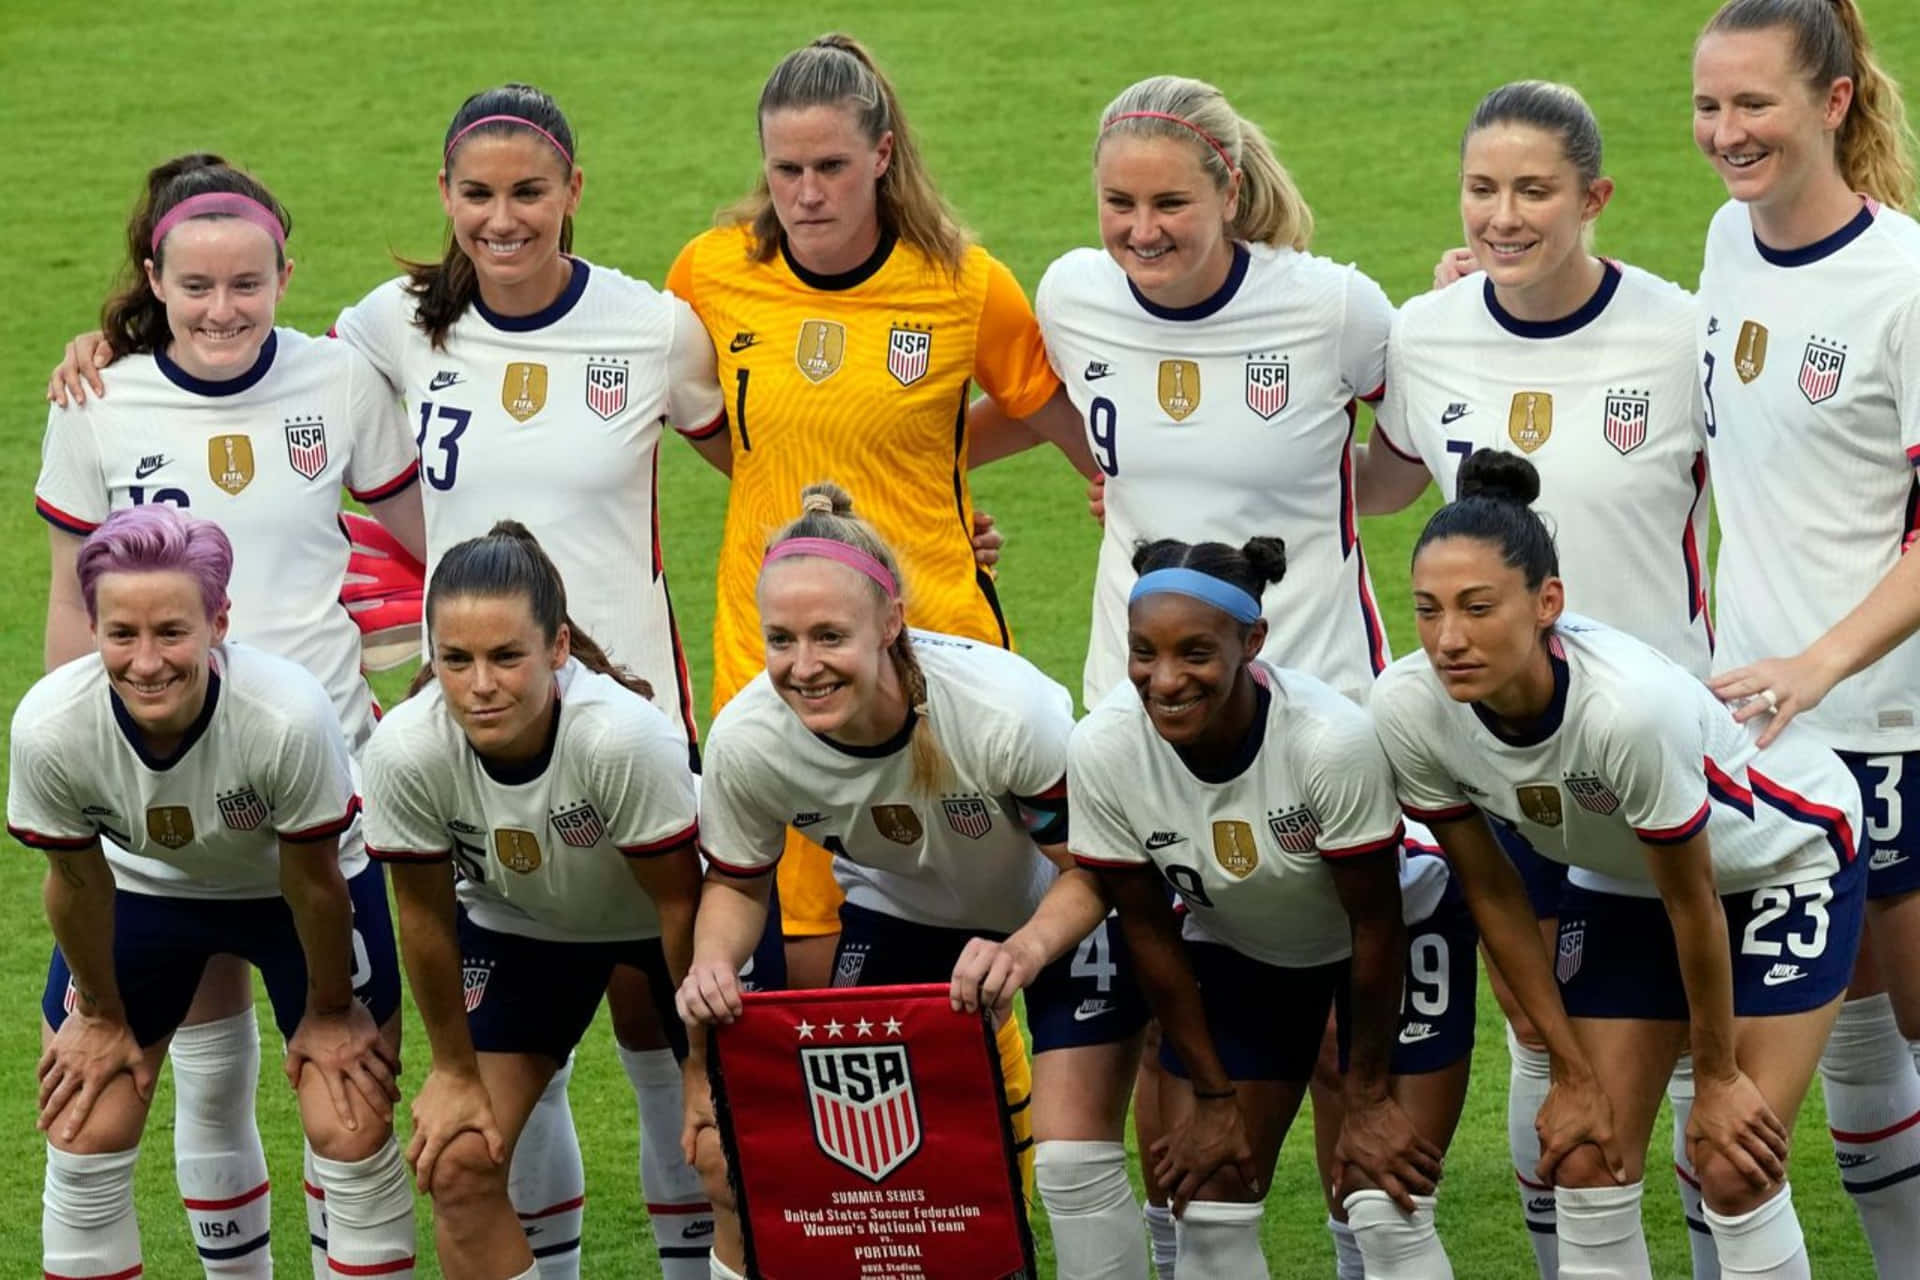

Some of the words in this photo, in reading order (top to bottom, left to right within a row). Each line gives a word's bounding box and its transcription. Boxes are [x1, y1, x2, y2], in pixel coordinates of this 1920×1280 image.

[893, 333, 927, 354] USA
[808, 359, 828, 369] FIFA
[1808, 348, 1841, 372] USA
[591, 369, 624, 389] USA
[1250, 368, 1285, 388] USA
[513, 399, 533, 409] FIFA
[736, 368, 751, 451] 1
[1169, 398, 1189, 408] FIFA
[1610, 402, 1645, 422] USA
[290, 428, 322, 449] USA
[1090, 396, 1118, 477] 9
[1519, 431, 1540, 440] FIFA
[416, 402, 472, 491] 13
[222, 472, 242, 481] FIFA
[1571, 781, 1603, 796] USA
[1865, 755, 1904, 842] 3
[223, 792, 257, 812] USA
[948, 802, 981, 818] USA
[557, 808, 592, 829] USA
[1274, 812, 1309, 834] USA
[1228, 855, 1249, 865] FIFA
[1741, 879, 1834, 959] 23
[1070, 919, 1117, 992] 4
[808, 1052, 905, 1103] USA
[832, 1190, 883, 1204] SUMMER
[886, 1189, 925, 1202] SERIES
[784, 1208, 824, 1223] United
[827, 1207, 867, 1221] States
[871, 1207, 910, 1220] Soccer
[914, 1204, 980, 1218] Federation
[199, 1220, 240, 1238] USA
[803, 1222, 865, 1237] Women's
[868, 1220, 926, 1235] National
[930, 1220, 965, 1233] Team
[854, 1244, 923, 1260] PORTUGAL
